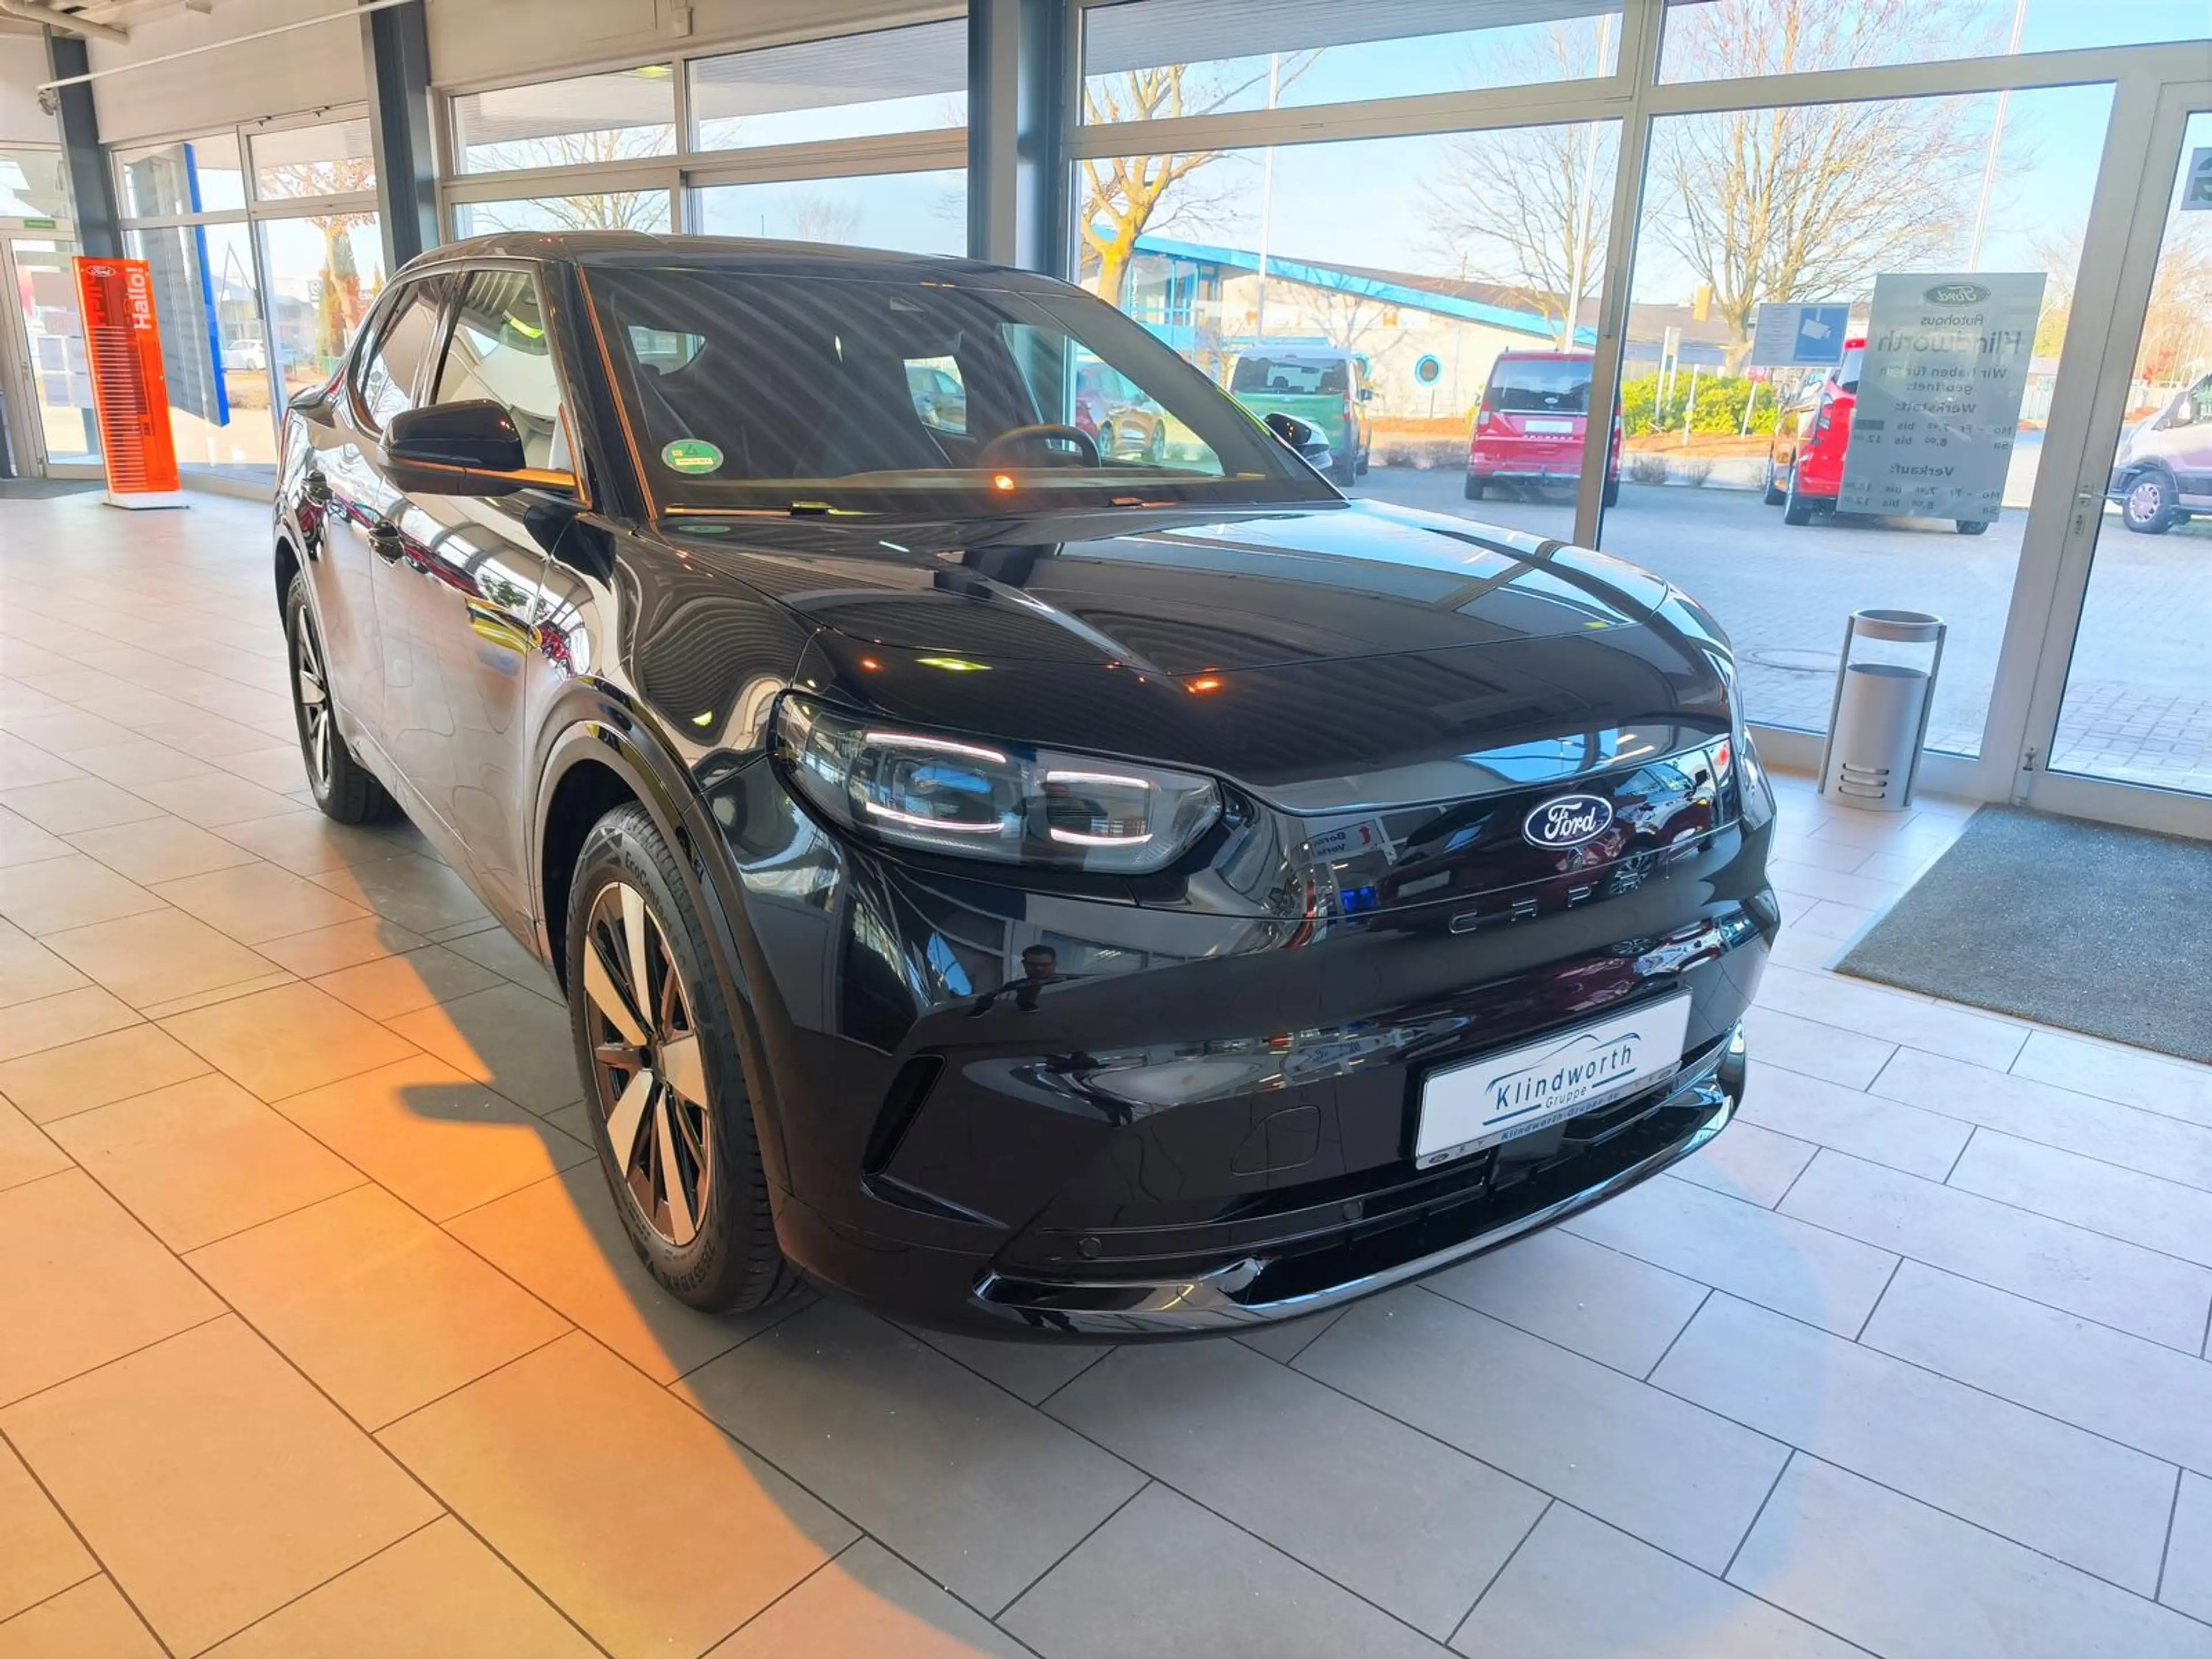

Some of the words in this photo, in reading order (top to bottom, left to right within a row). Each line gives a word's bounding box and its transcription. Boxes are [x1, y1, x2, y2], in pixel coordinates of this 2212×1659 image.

[126, 267, 151, 330] Hallo!
[1544, 801, 1597, 840] Ford
[1495, 1044, 1632, 1110] Klindworth
[1544, 1085, 1588, 1109] Gruppe
